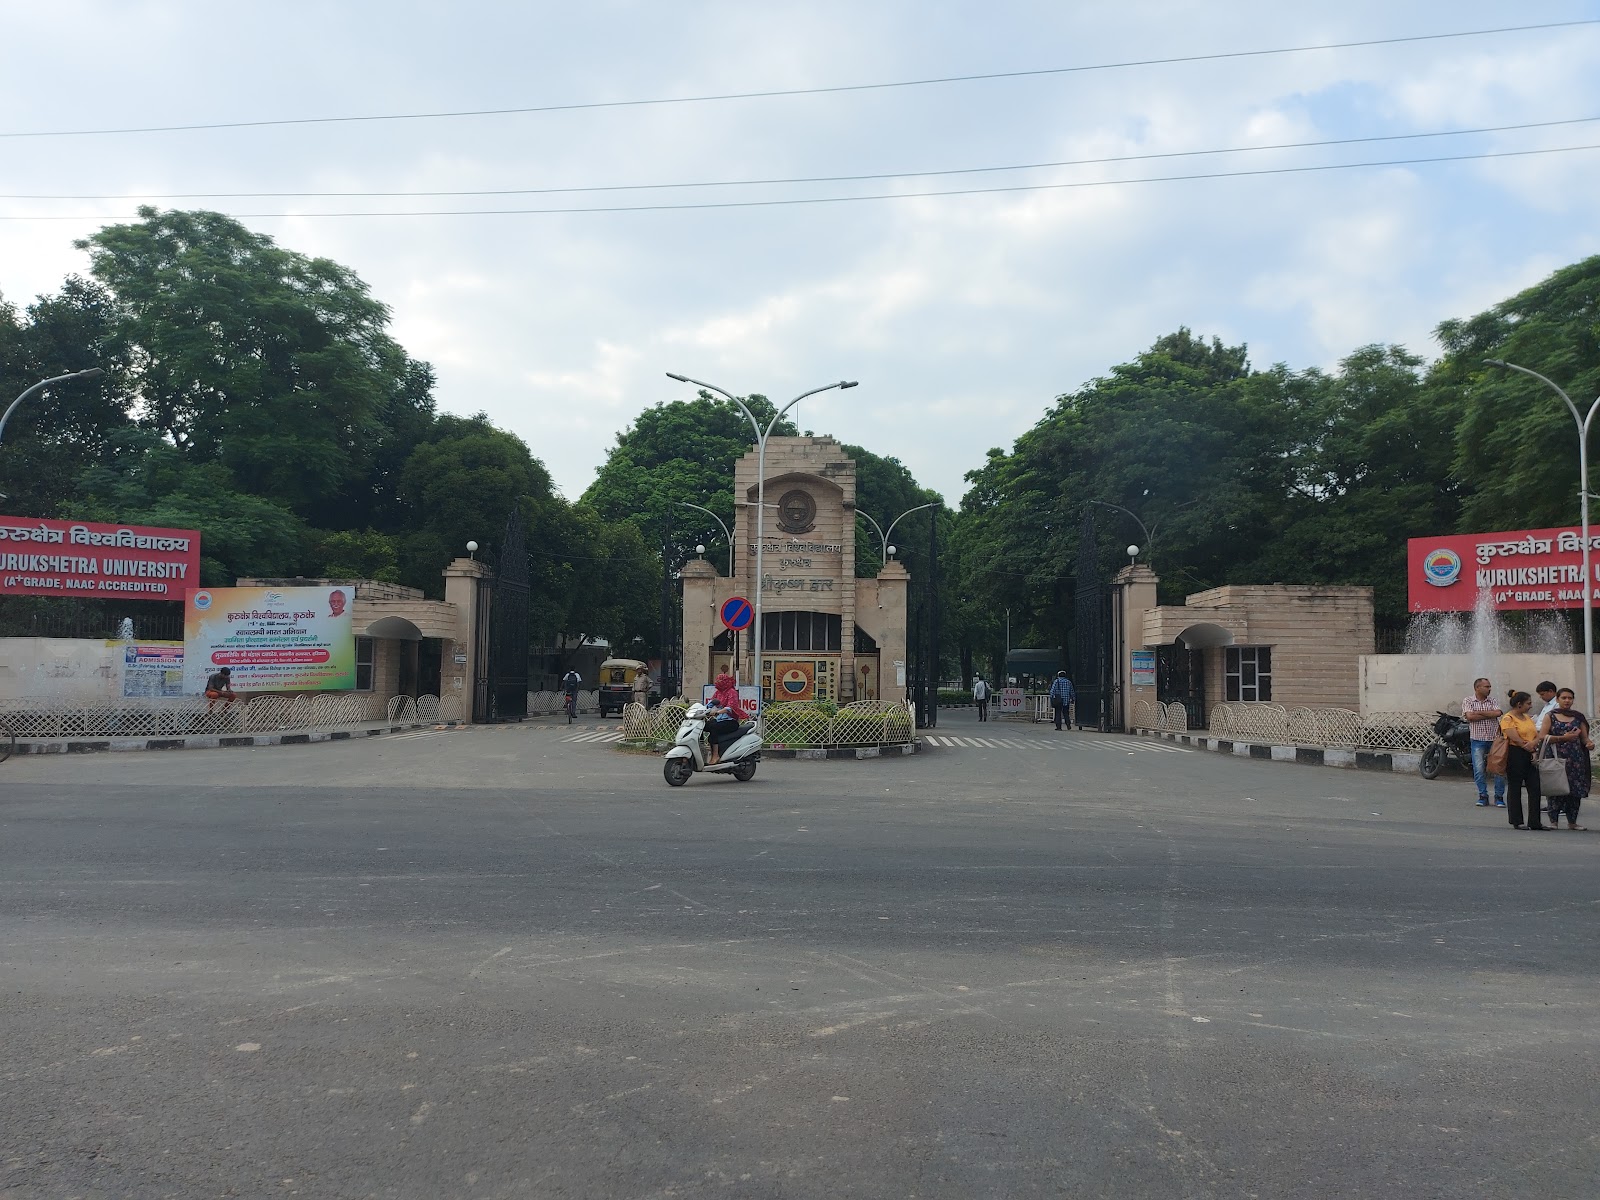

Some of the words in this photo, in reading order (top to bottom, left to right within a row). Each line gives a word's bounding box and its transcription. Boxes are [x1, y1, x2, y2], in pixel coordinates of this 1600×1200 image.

[69, 526, 190, 552] विश्वविद्यालय
[1476, 534, 1552, 565] कुरुक्षेत्र
[102, 558, 188, 579] UNIVERSITY
[66, 579, 95, 590] NAAC
[98, 580, 168, 595] ACCREDITED)
[1003, 698, 1021, 707] STOP
